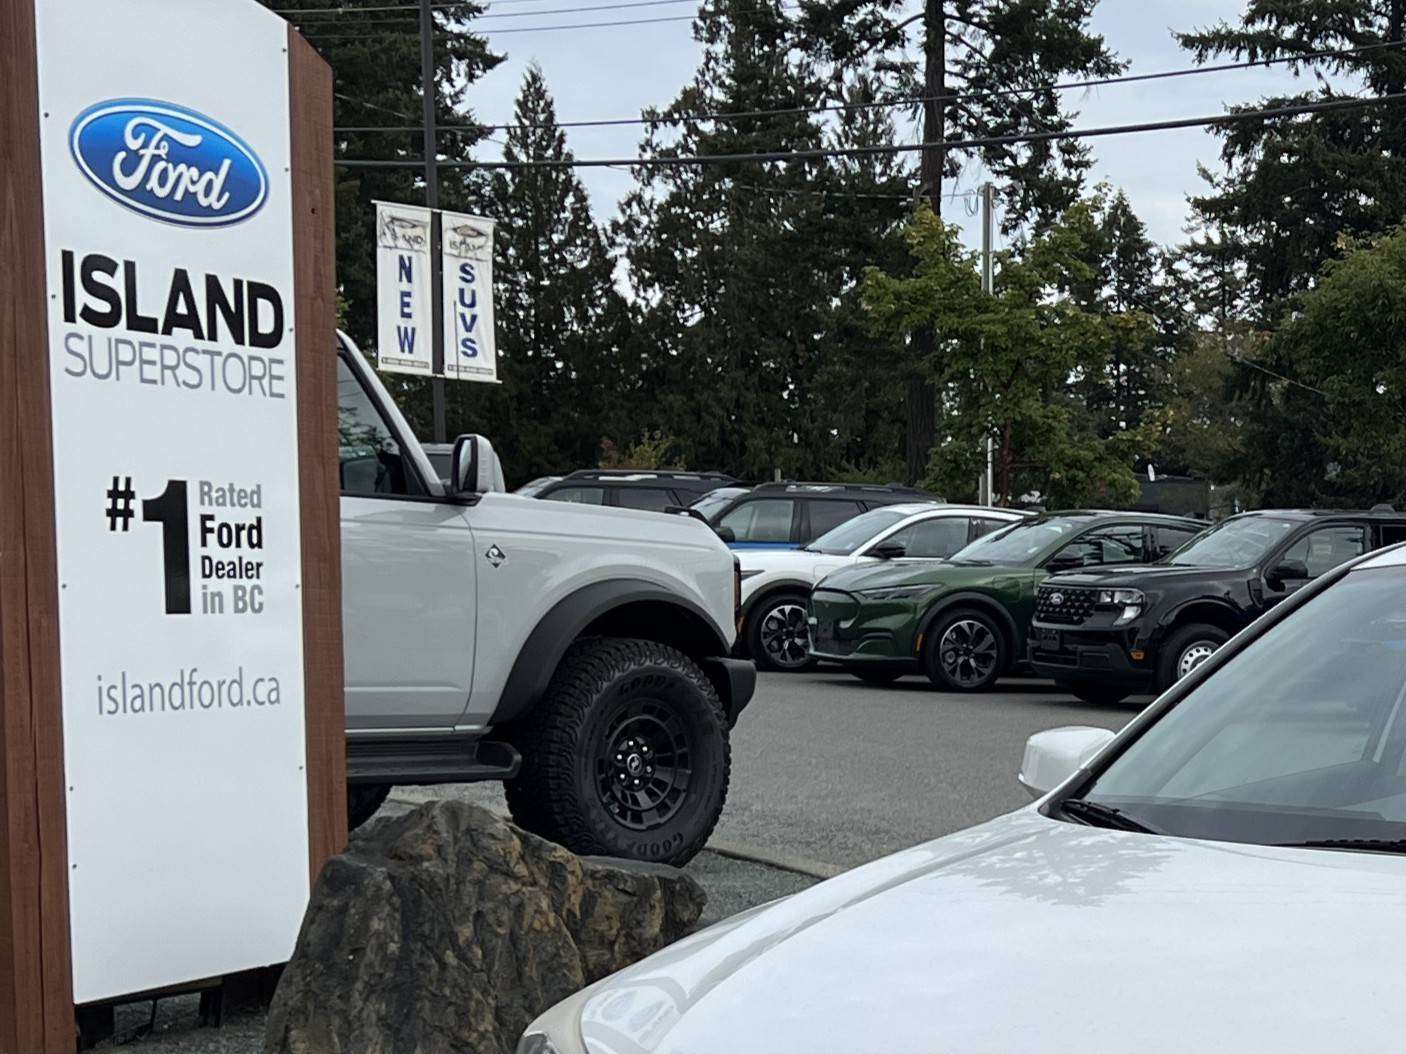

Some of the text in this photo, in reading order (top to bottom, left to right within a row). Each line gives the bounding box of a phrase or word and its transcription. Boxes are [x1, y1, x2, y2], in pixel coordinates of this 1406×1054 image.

[112, 116, 232, 210] Ford
[61, 249, 284, 349] ISLAND
[396, 254, 416, 355] NEW
[458, 262, 478, 358] SUVS
[64, 332, 286, 399] SUPERSTORE
[198, 480, 263, 509] Rated
[199, 514, 264, 549] Ford
[200, 555, 264, 580] Dealer
[201, 584, 264, 615] in BC
[97, 666, 281, 716] islandford.ca
